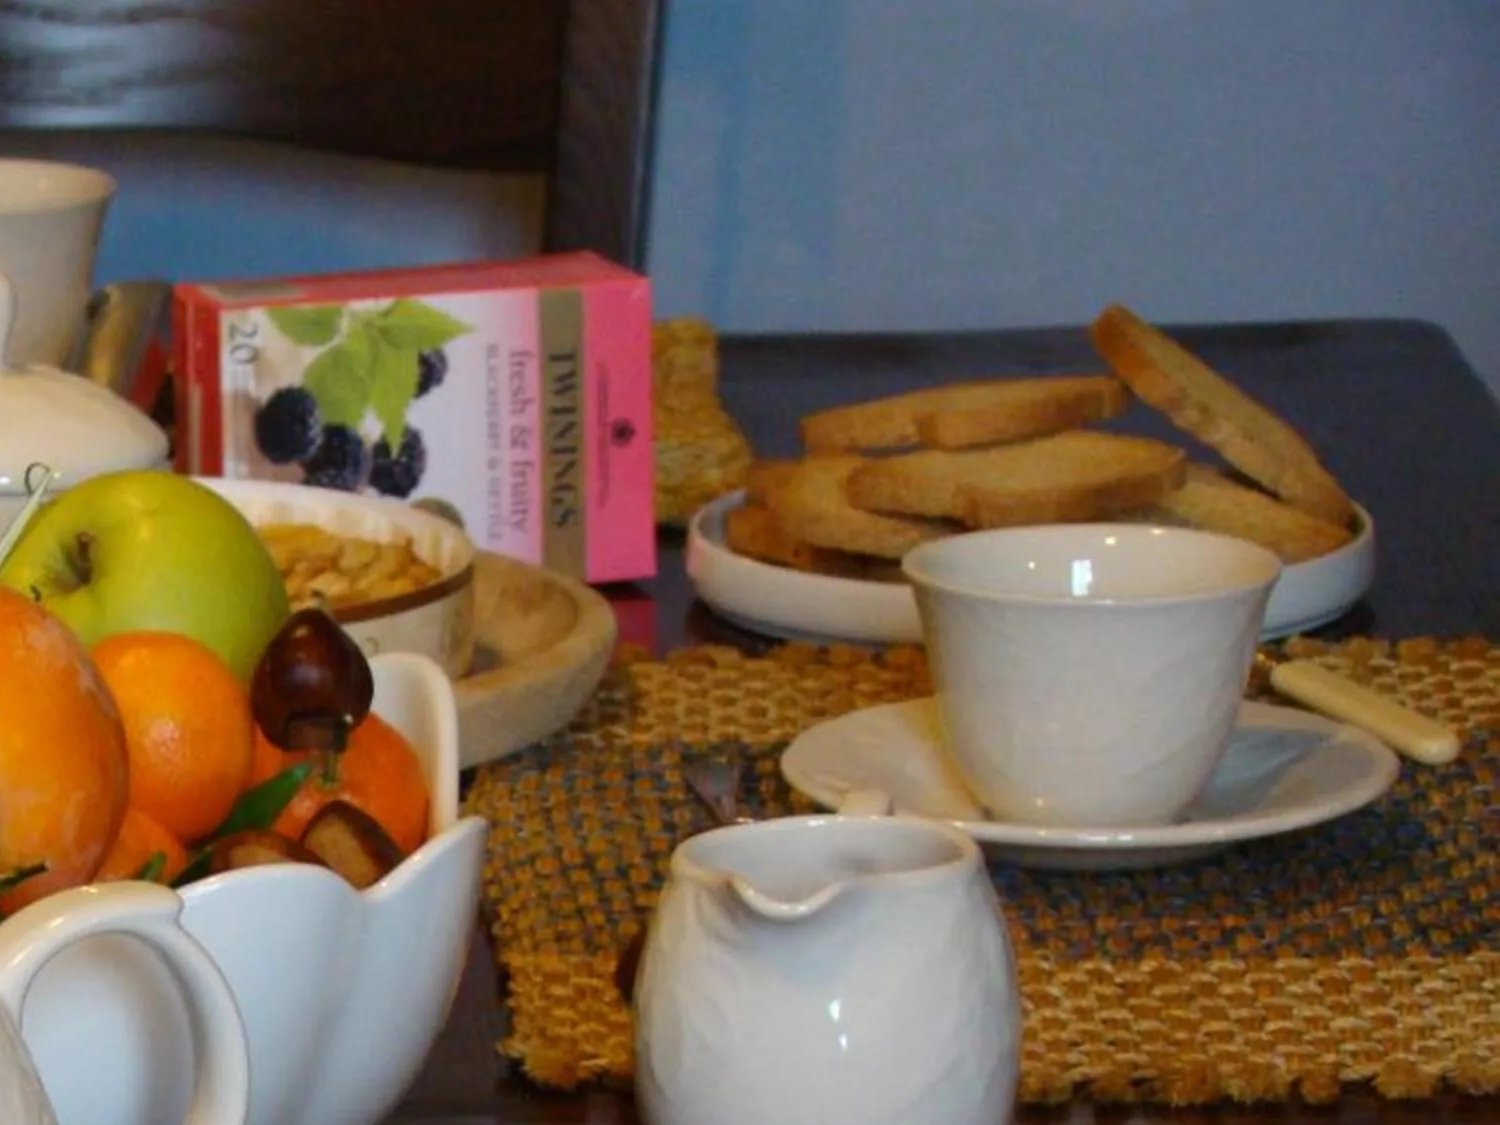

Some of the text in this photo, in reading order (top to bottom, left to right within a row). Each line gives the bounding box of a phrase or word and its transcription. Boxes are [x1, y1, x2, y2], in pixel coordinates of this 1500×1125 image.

[229, 322, 261, 365] 20
[509, 350, 536, 534] fresh & fruity
[548, 349, 578, 528] TWININGS
